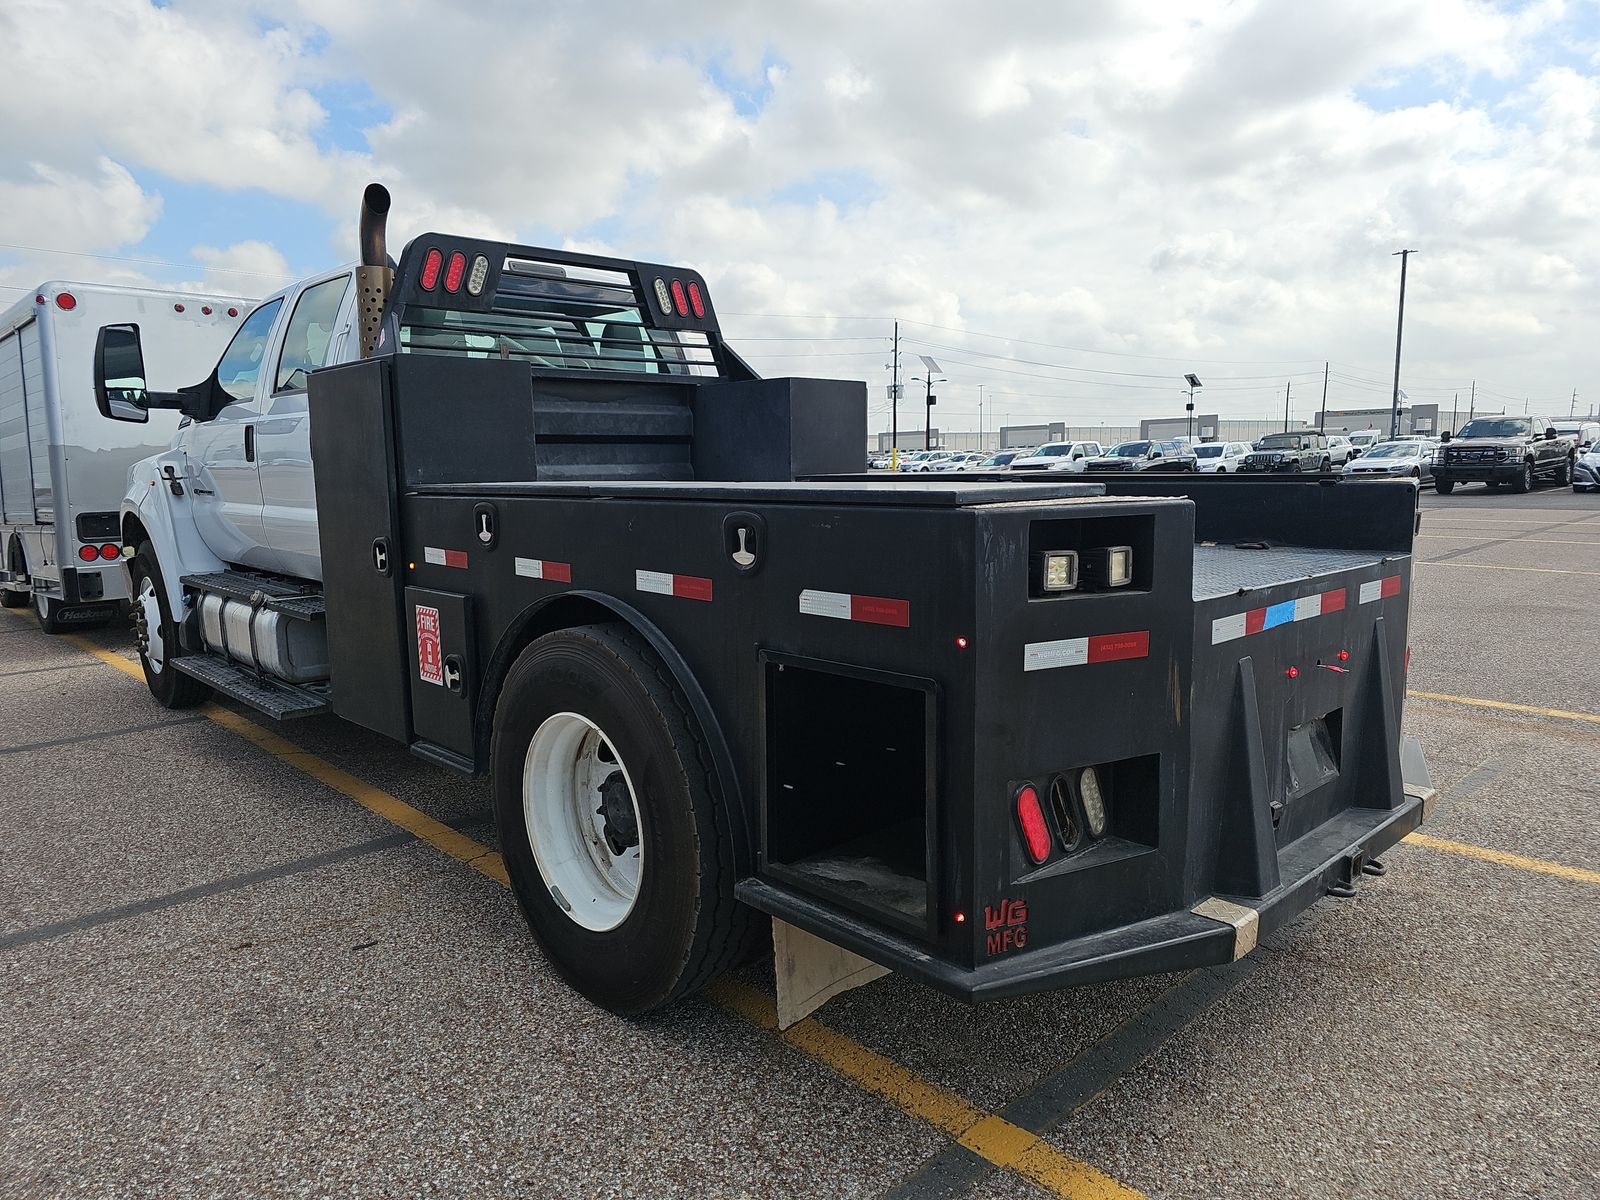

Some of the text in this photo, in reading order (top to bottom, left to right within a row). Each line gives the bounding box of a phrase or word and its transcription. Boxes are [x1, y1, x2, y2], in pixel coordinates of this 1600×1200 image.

[420, 614, 435, 632] FIRE
[985, 899, 1027, 929] WG
[987, 926, 1027, 956] MFG
